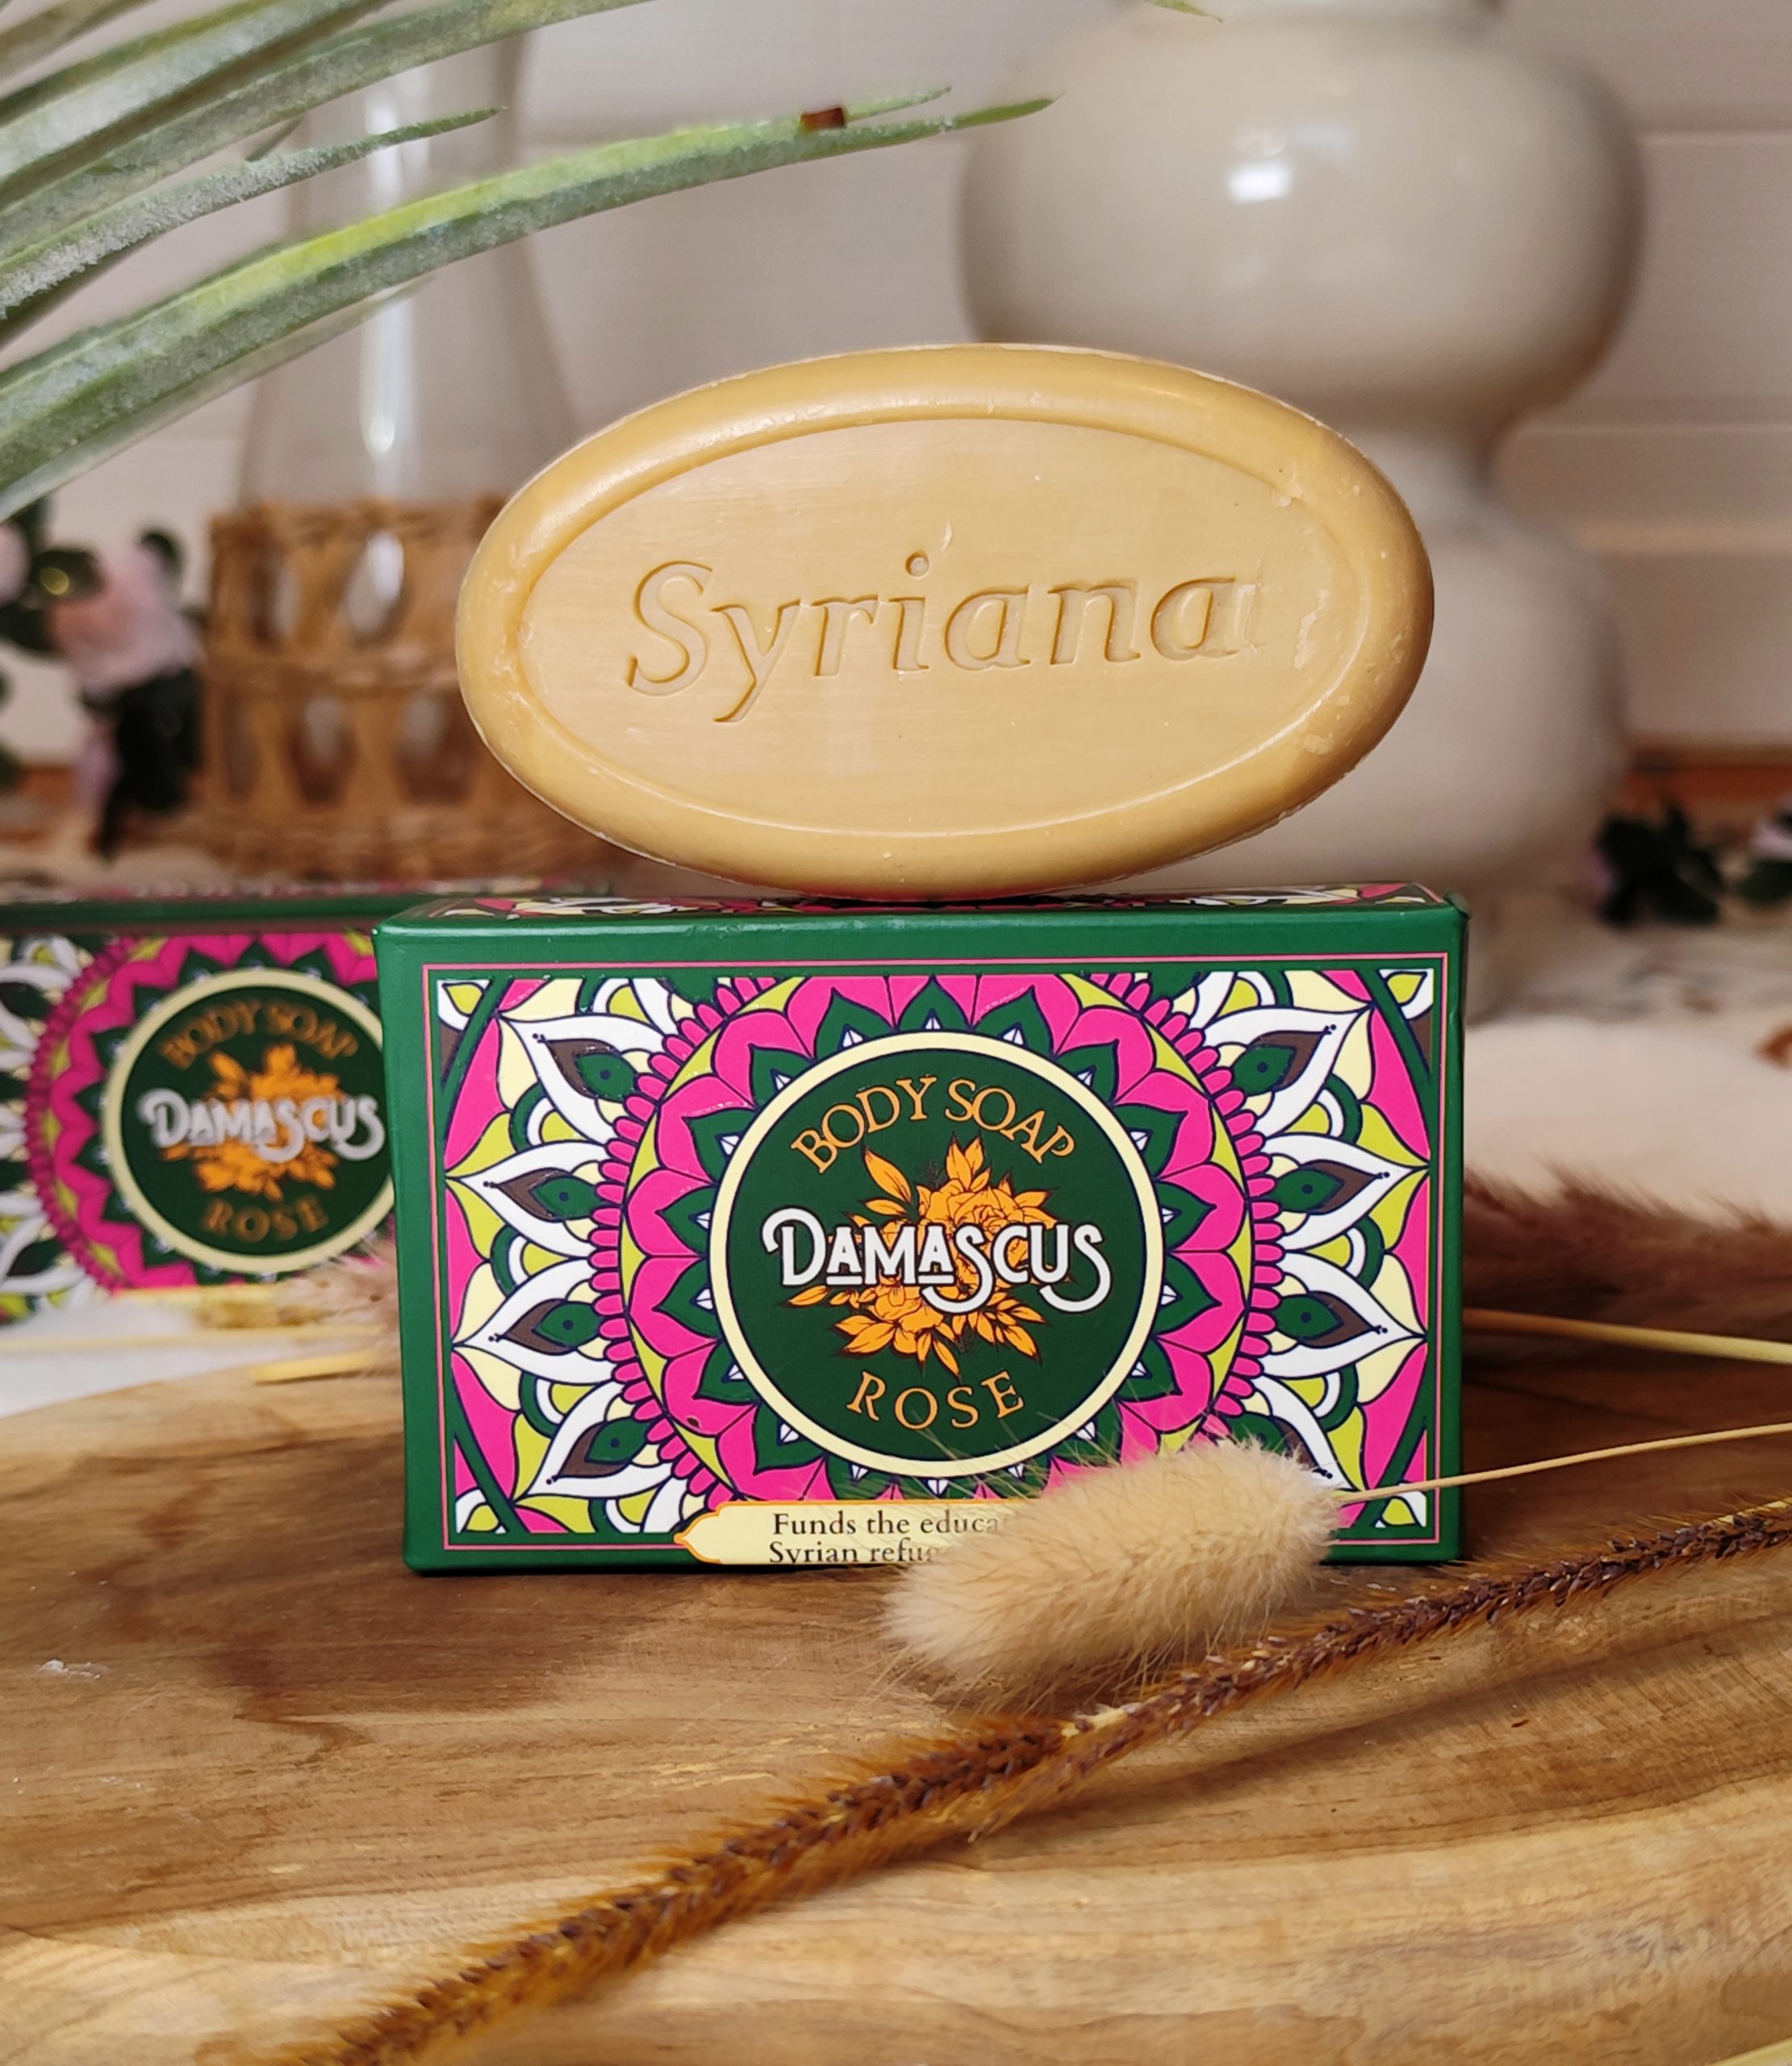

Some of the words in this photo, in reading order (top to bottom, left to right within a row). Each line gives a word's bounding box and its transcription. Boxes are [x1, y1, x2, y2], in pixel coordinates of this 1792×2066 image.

[624, 550, 1264, 723] Syriana
[791, 1074, 937, 1174] BODY
[945, 1079, 1075, 1165] SOAP
[202, 1197, 329, 1244] ROSE
[761, 1207, 1111, 1313] DAMASCUS
[846, 1371, 1025, 1431] ROSE
[769, 1538, 858, 1564] Syrian
[772, 1510, 857, 1535] Funds
[867, 1509, 910, 1534] the
[920, 1508, 1009, 1534] educa
